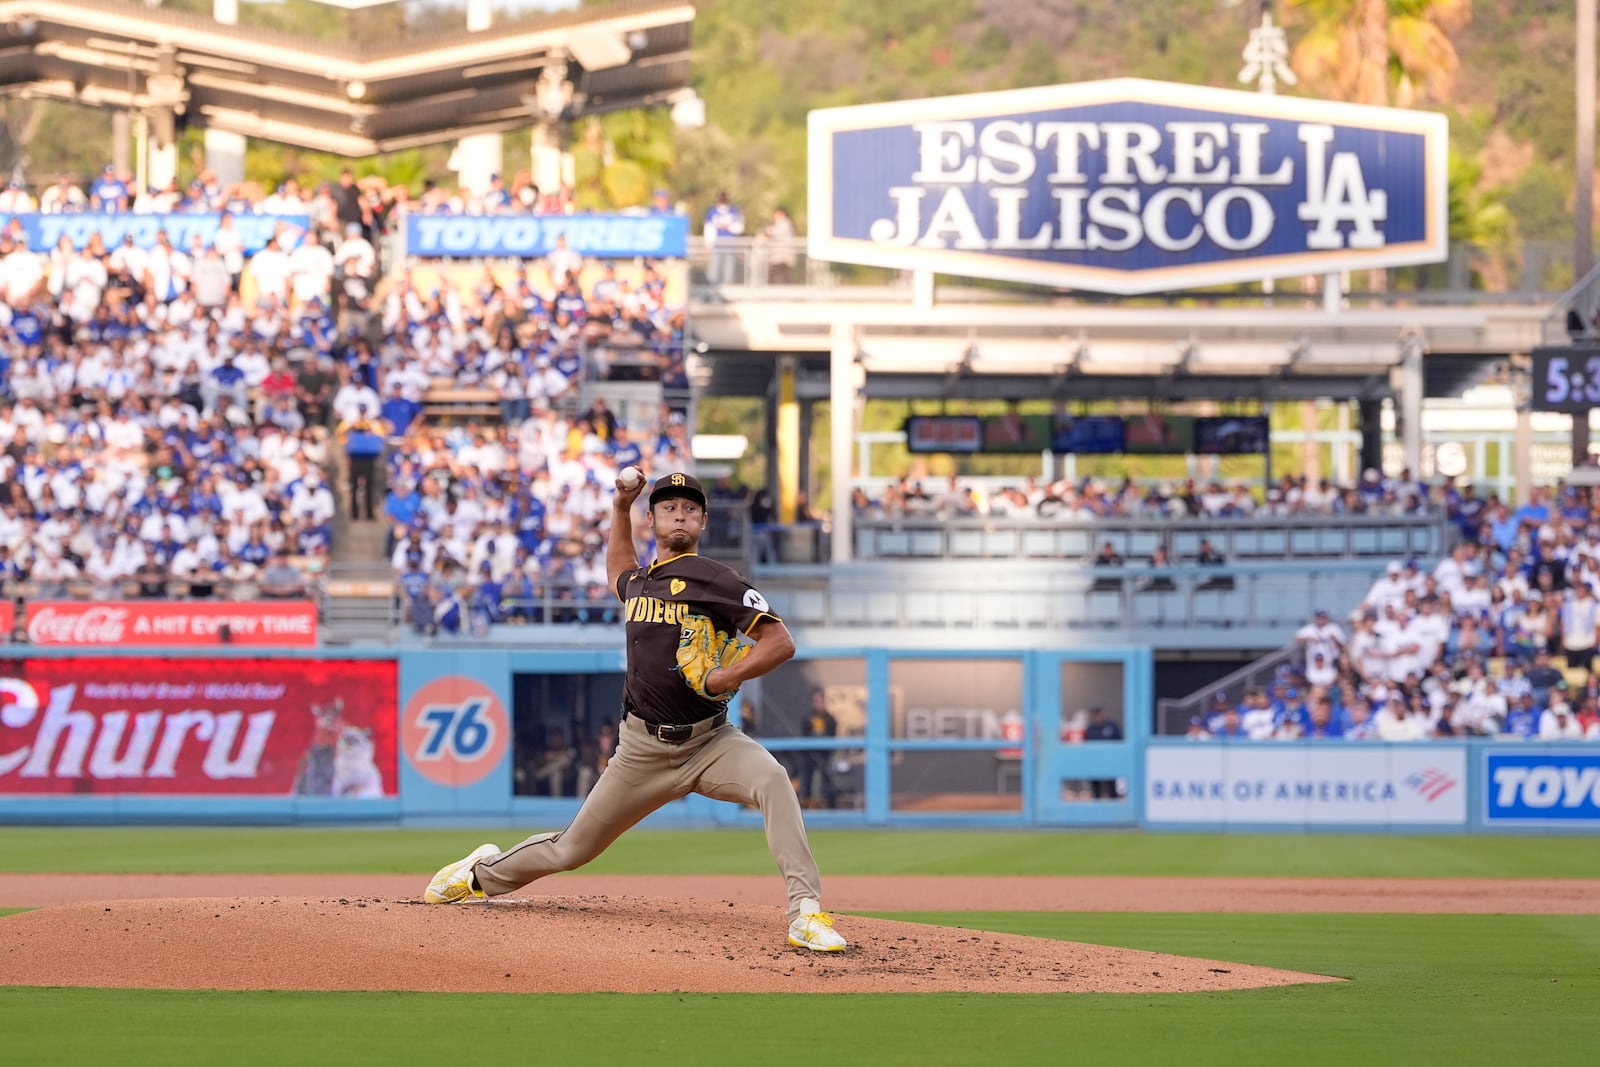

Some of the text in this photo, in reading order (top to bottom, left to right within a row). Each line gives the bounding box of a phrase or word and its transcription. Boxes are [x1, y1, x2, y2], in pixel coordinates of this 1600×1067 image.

[912, 121, 1294, 185] ESTREL
[1298, 124, 1388, 249] LA
[38, 214, 160, 249] TOYO
[417, 218, 667, 251] TOYO TIRES
[869, 187, 1275, 251] JALISCO
[133, 615, 151, 635] A
[153, 615, 188, 635] HIT
[261, 615, 312, 635] TIME
[633, 596, 690, 625] DIEGO
[417, 700, 493, 758] 76
[1152, 780, 1396, 802] BANK OF AMERICA
[1493, 766, 1600, 809] TOY
